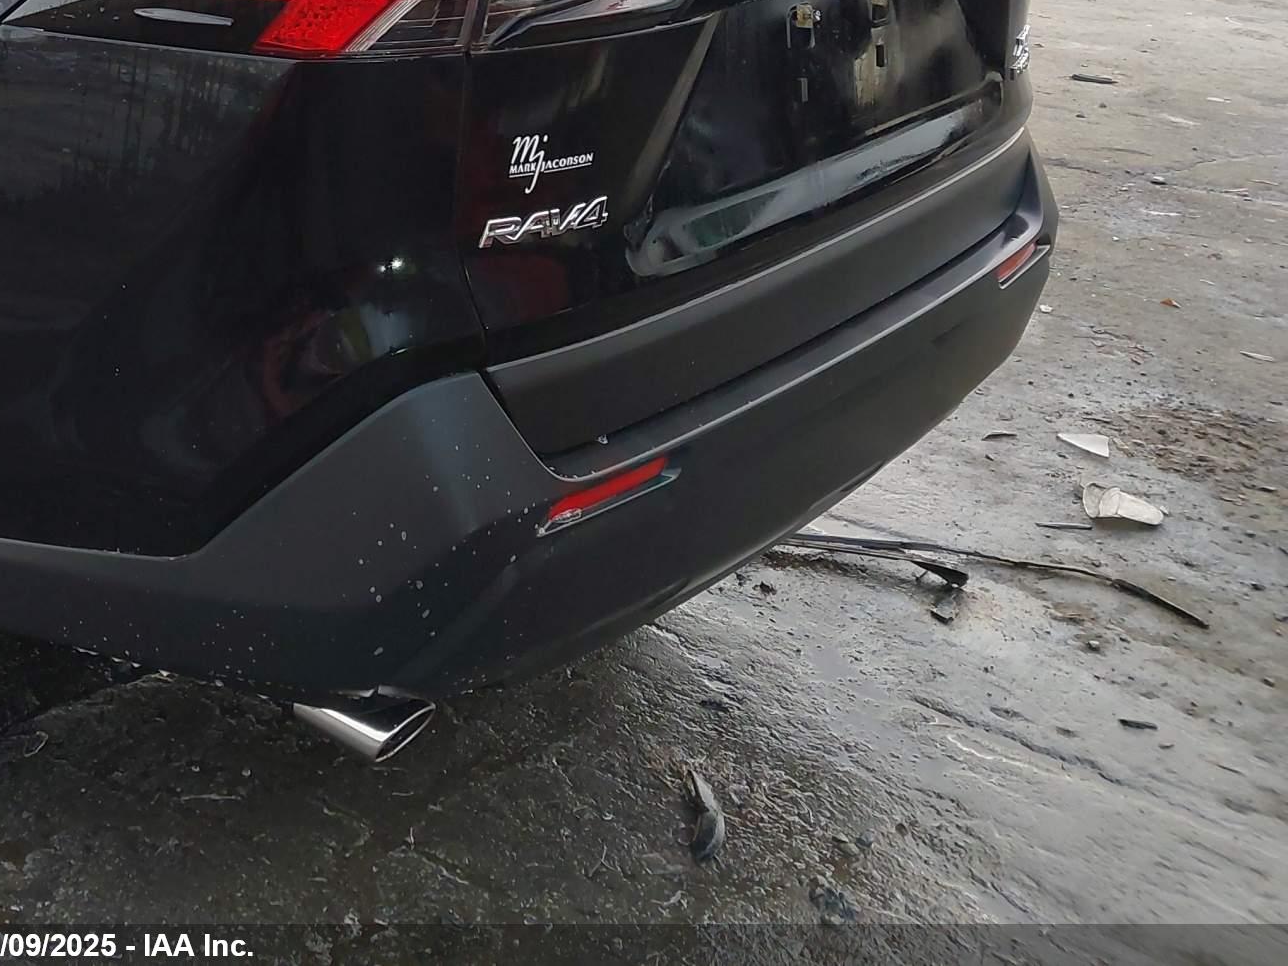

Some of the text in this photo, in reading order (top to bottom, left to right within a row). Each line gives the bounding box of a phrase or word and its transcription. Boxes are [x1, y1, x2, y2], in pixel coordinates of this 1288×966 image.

[509, 152, 594, 175] MARK JACOBSON
[478, 195, 609, 249] RAV4
